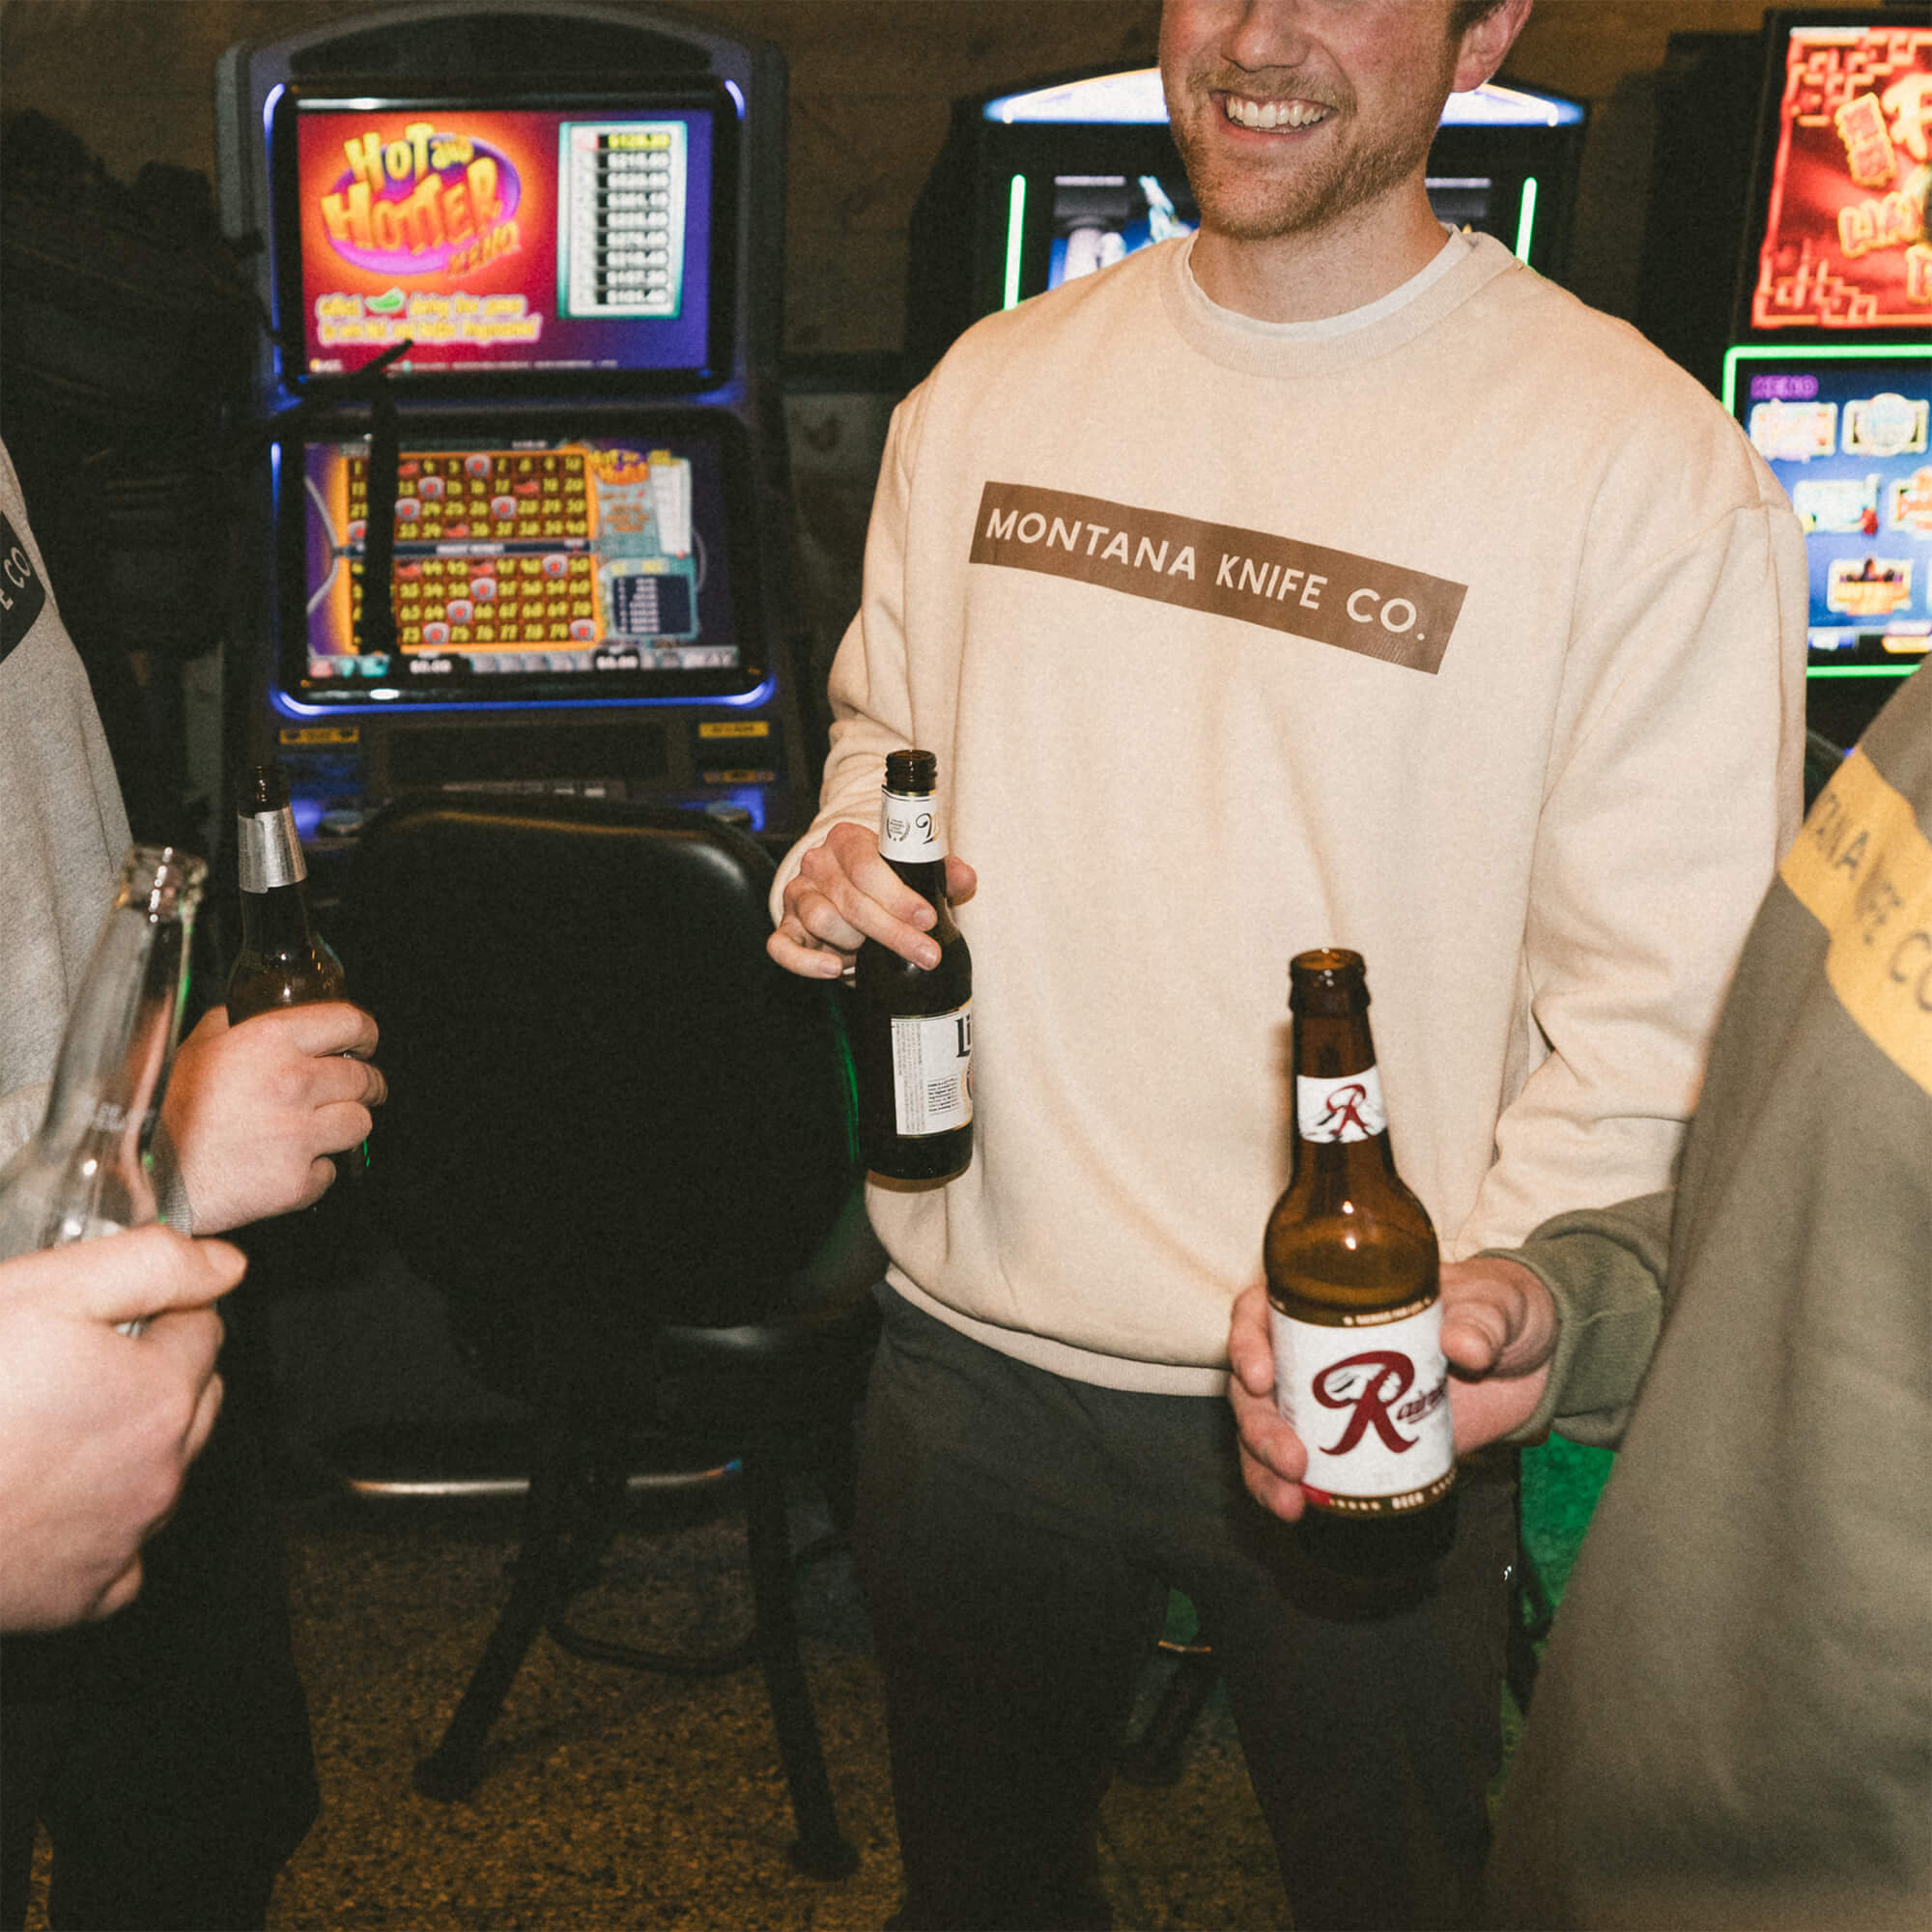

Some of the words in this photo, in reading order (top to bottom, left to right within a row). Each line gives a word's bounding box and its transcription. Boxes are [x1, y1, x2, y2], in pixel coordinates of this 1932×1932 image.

[320, 157, 502, 257] HOTTER
[343, 122, 435, 192] HOT
[984, 507, 1196, 581] MONTANA
[1215, 554, 1329, 611] KNIFE
[1346, 587, 1427, 641] CO.
